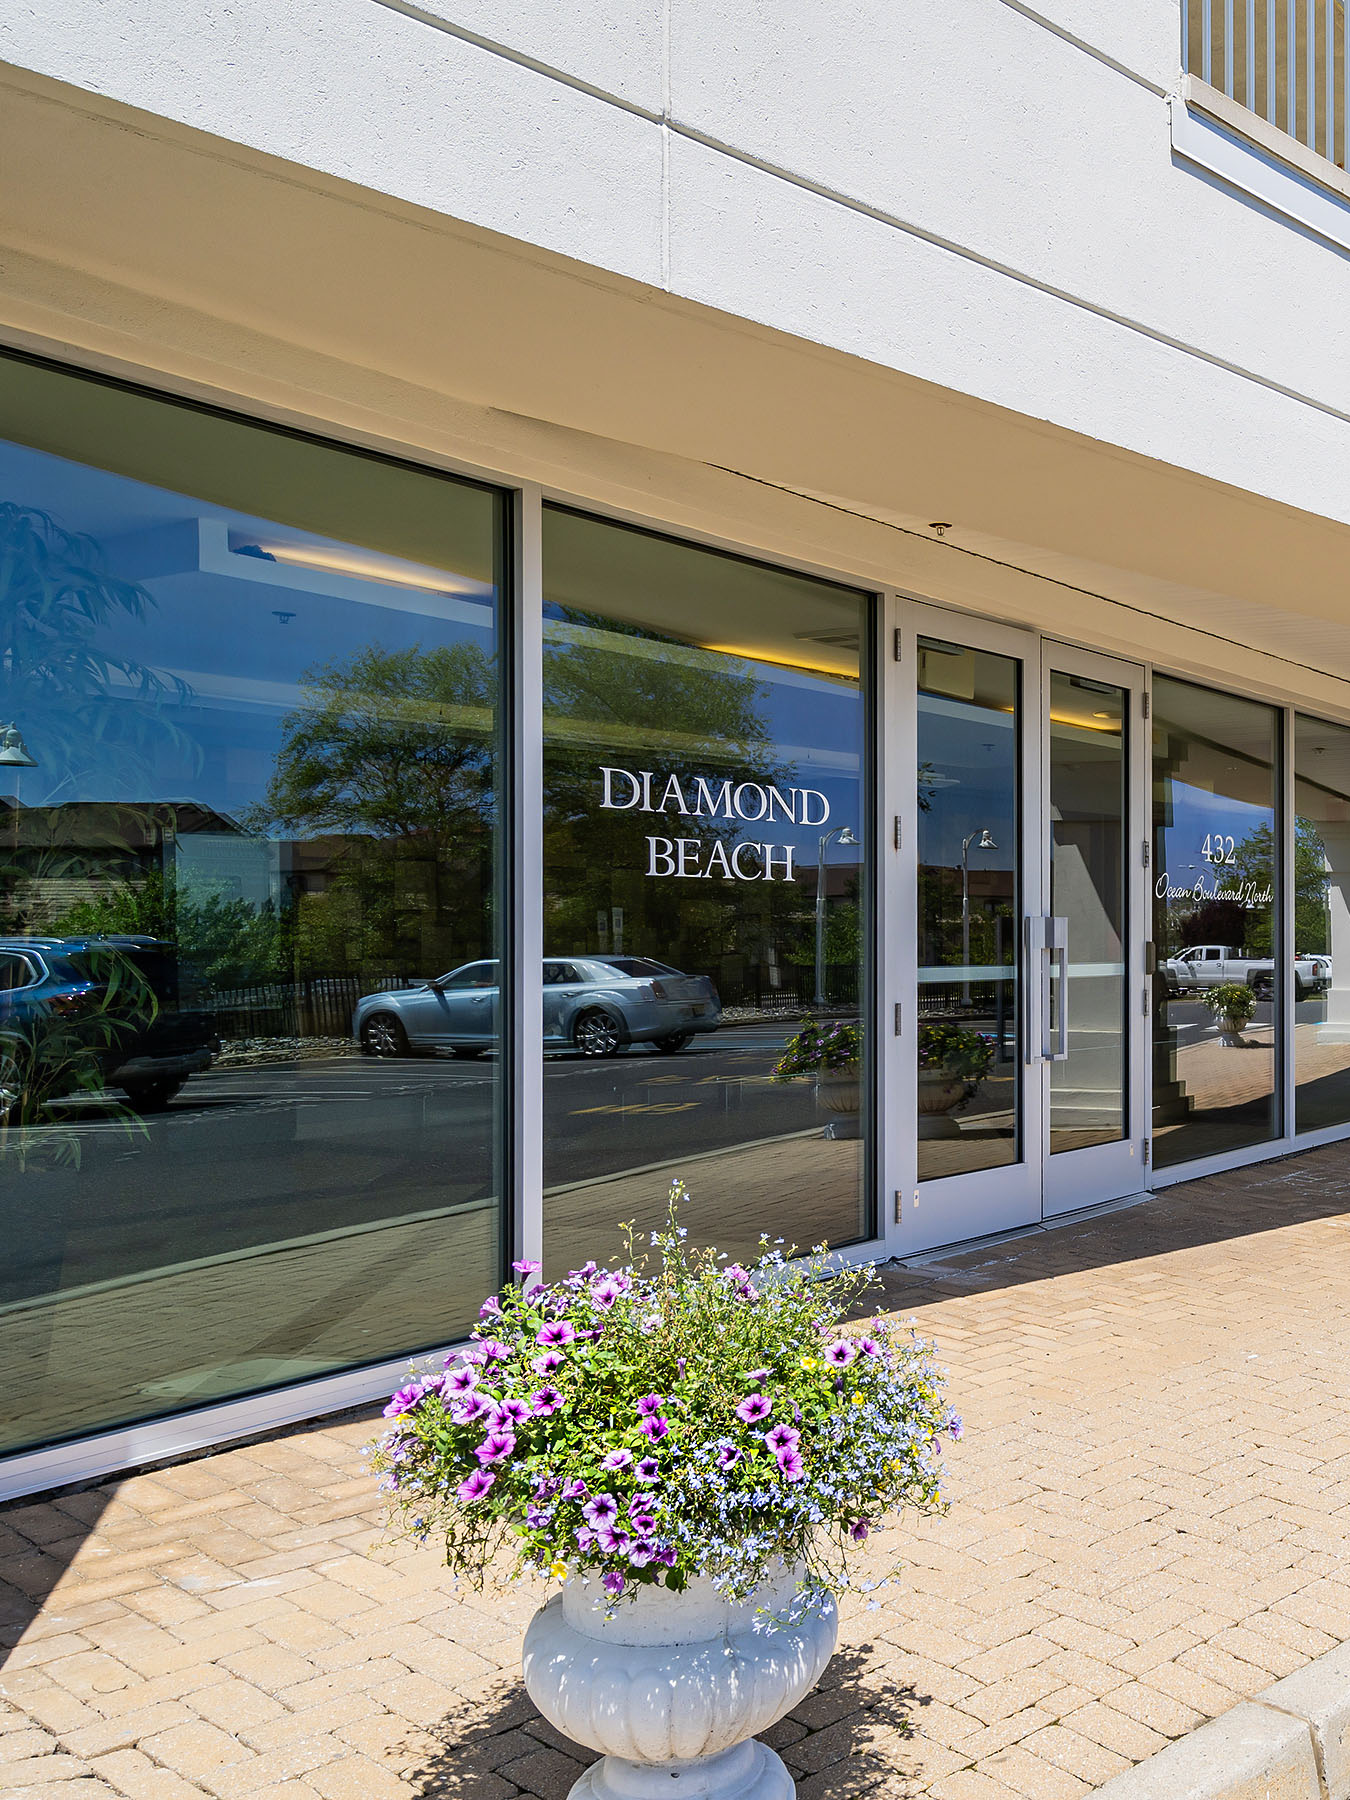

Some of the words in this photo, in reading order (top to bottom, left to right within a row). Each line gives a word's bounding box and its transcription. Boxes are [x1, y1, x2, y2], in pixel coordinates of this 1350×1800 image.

[599, 766, 831, 826] DIAMOND
[644, 835, 797, 882] BEACH
[1201, 833, 1236, 865] 432
[1155, 872, 1192, 899] Ocean
[1192, 874, 1244, 902] Boulevard
[1238, 880, 1274, 907] North
